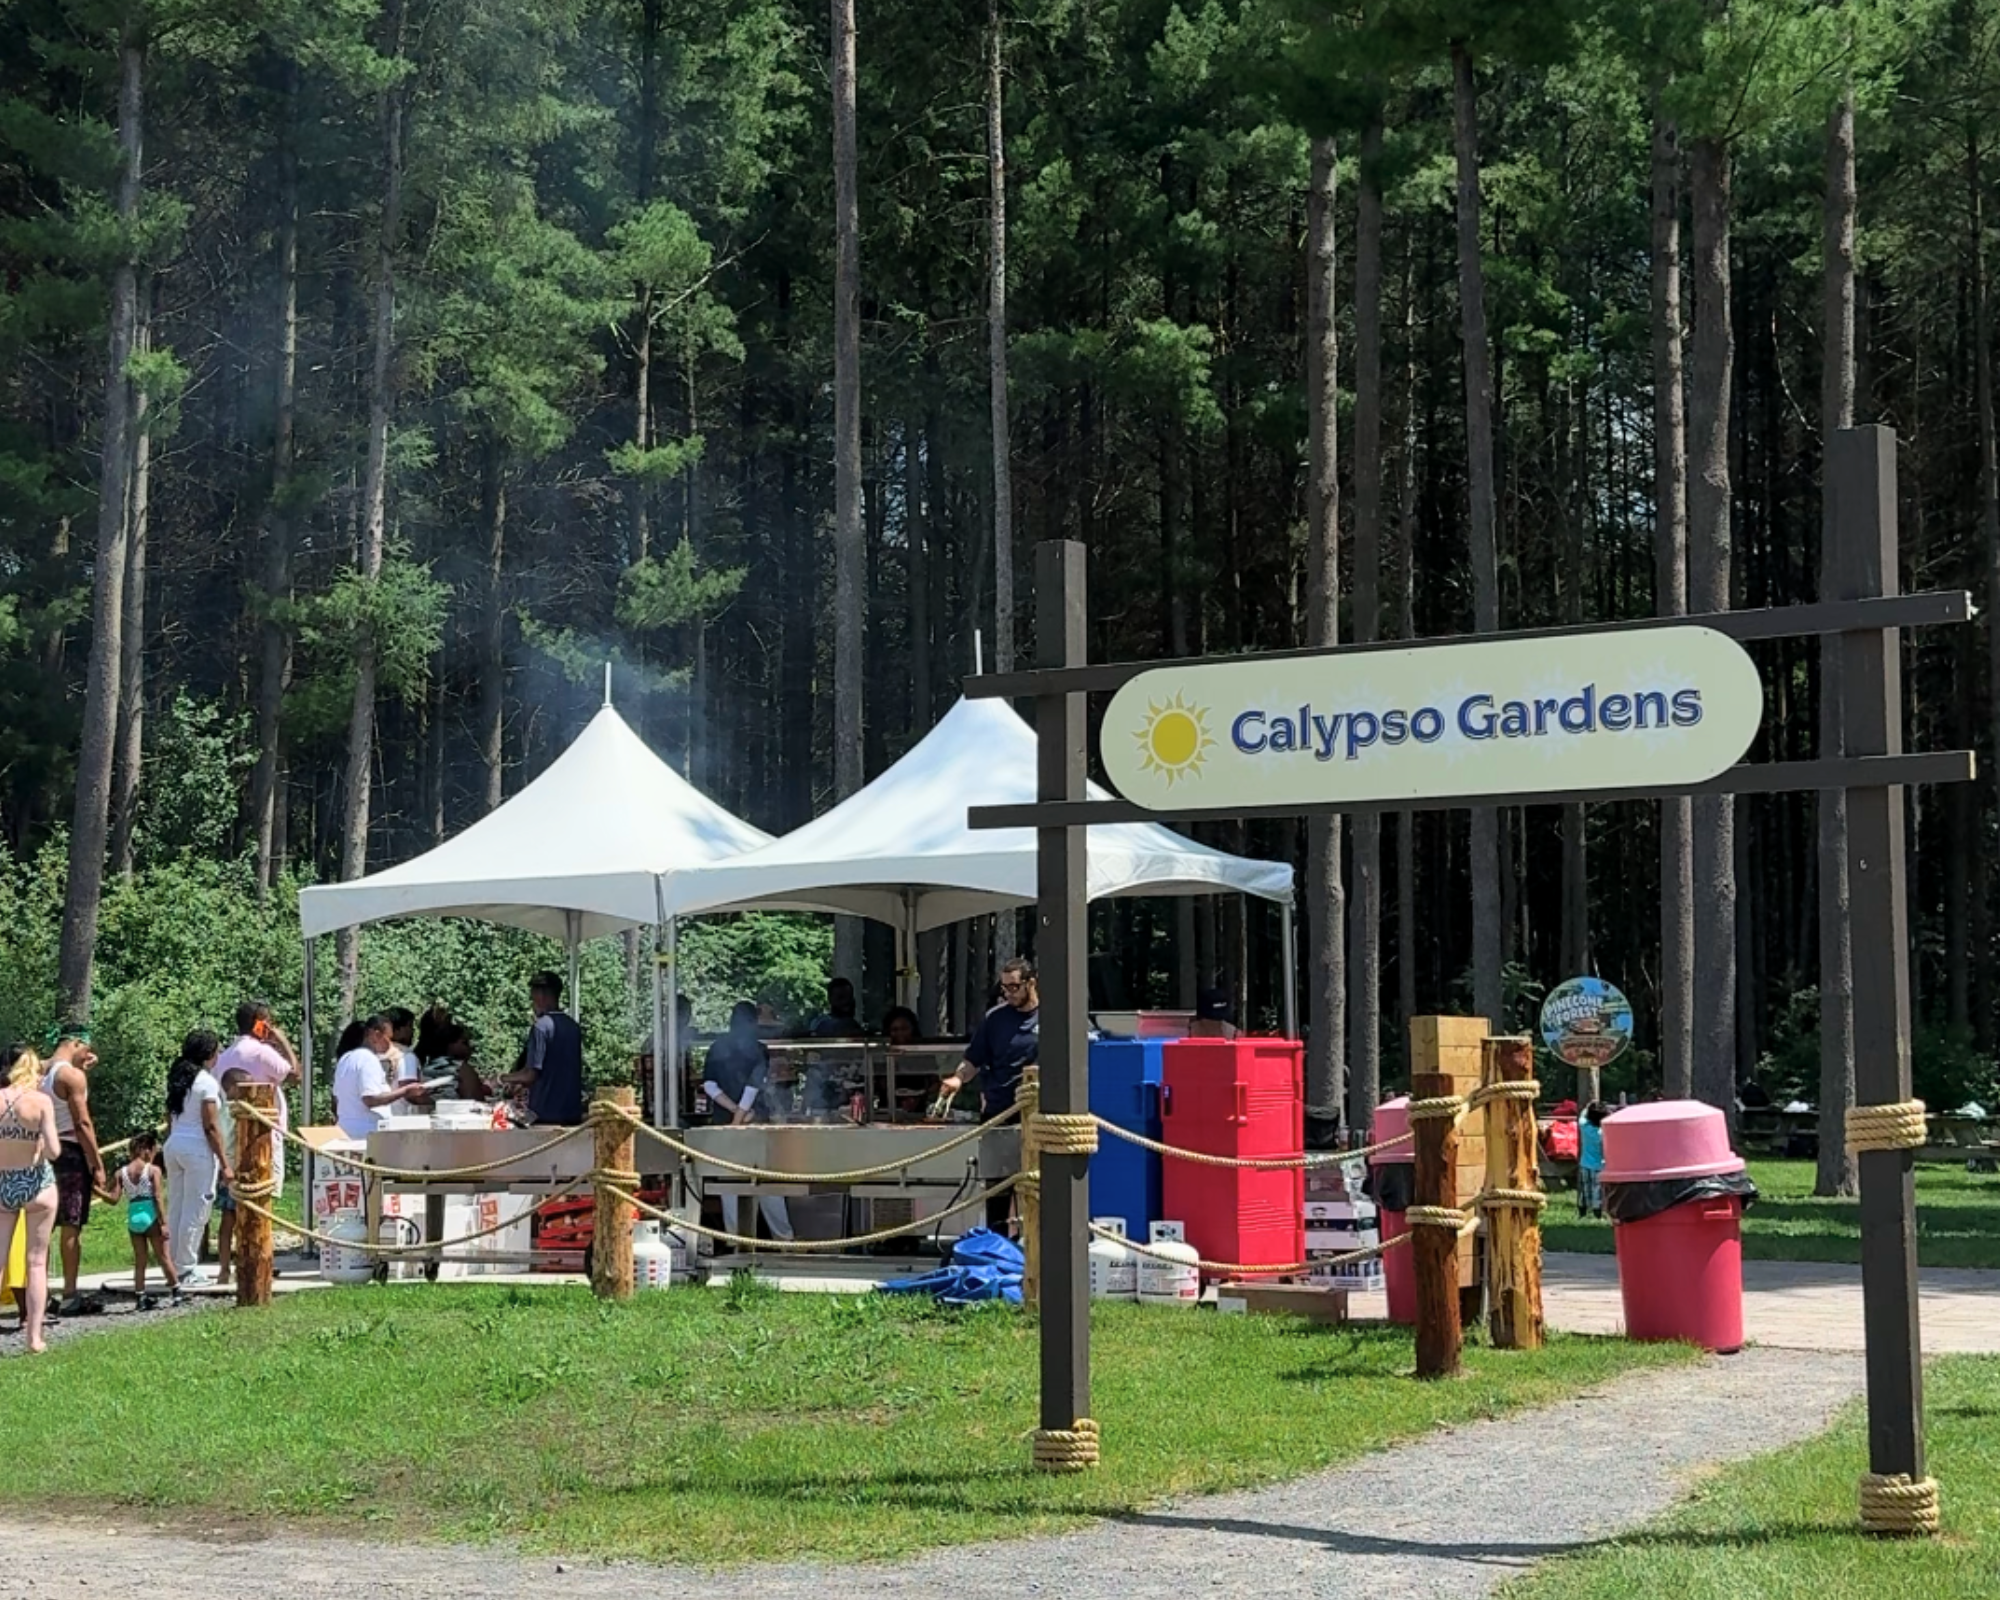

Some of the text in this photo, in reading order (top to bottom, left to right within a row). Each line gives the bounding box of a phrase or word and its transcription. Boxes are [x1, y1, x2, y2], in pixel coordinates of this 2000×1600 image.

[1231, 684, 1704, 762] Calypso Gardens
[1556, 1006, 1599, 1026] FOREST
